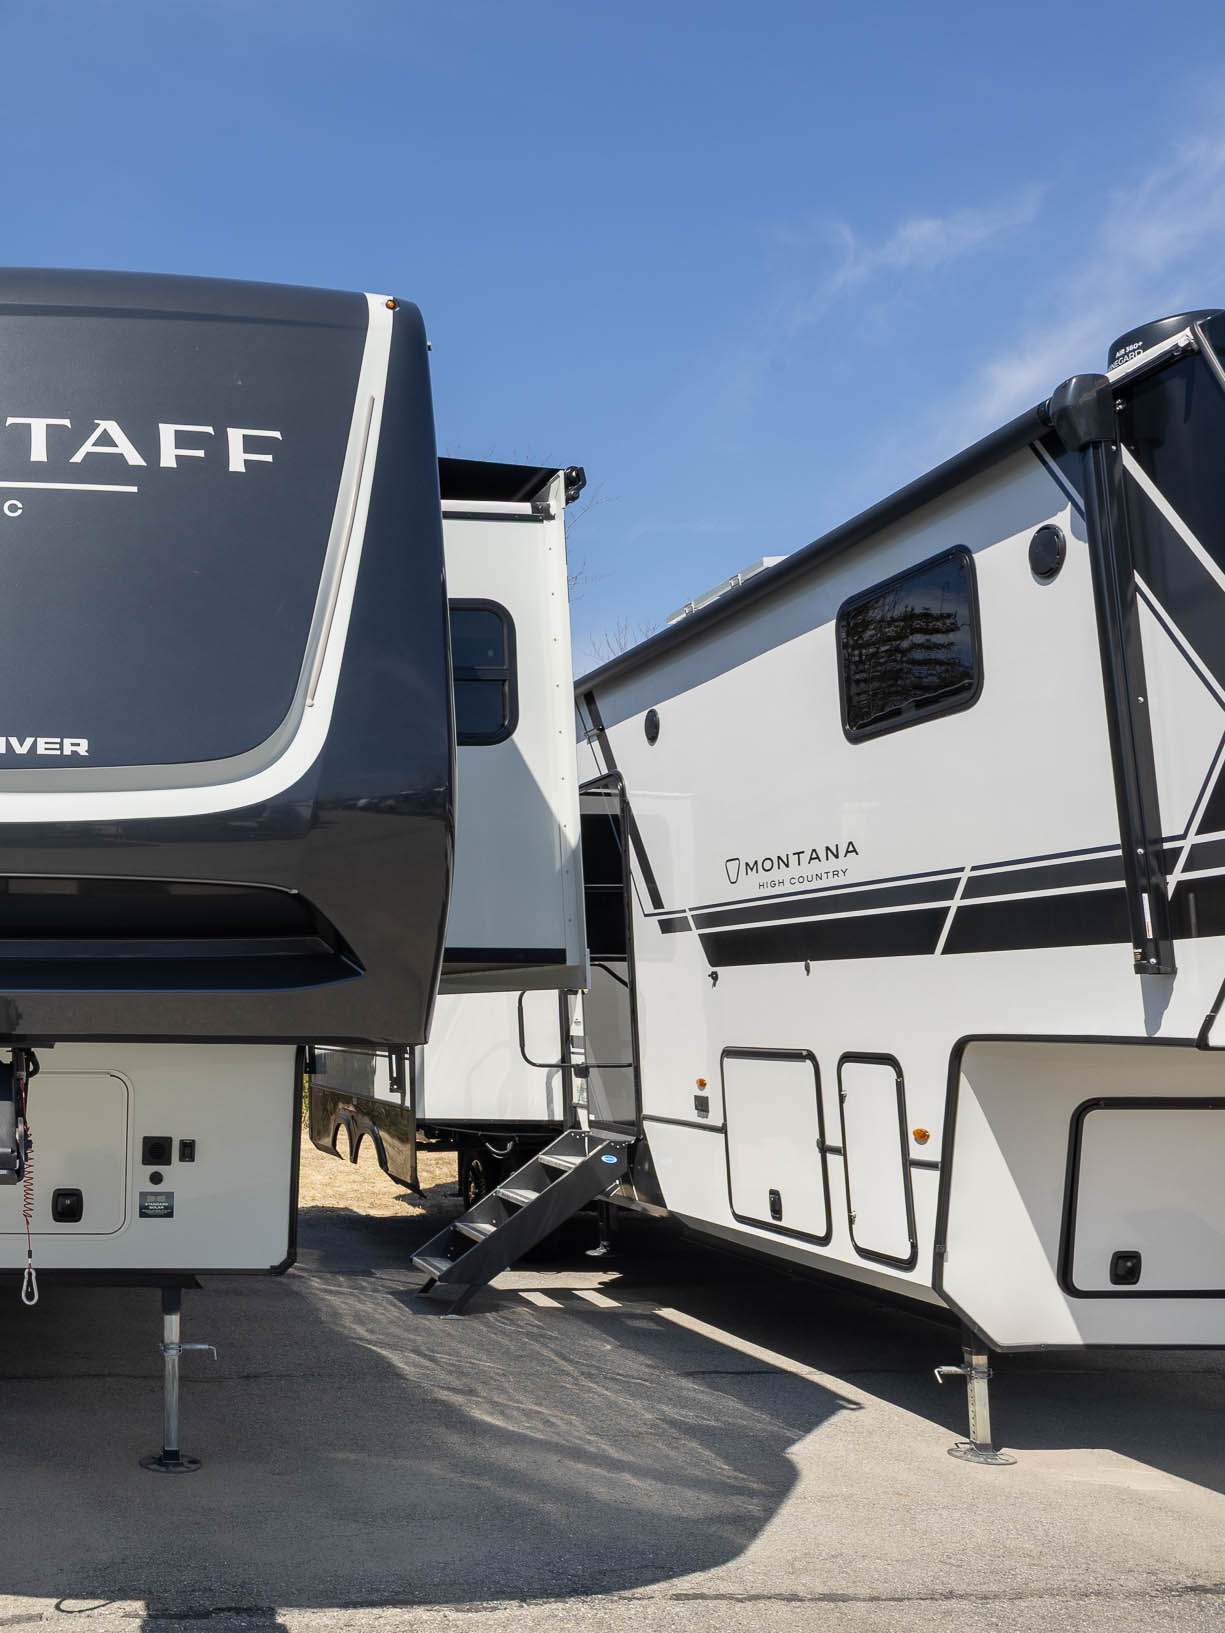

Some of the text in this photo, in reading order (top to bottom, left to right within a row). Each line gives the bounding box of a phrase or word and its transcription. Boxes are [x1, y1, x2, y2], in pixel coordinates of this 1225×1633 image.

[1116, 341, 1143, 358] AIR 360+
[744, 840, 860, 876] MONTANA
[758, 867, 849, 890] HIGH COUNTRY
